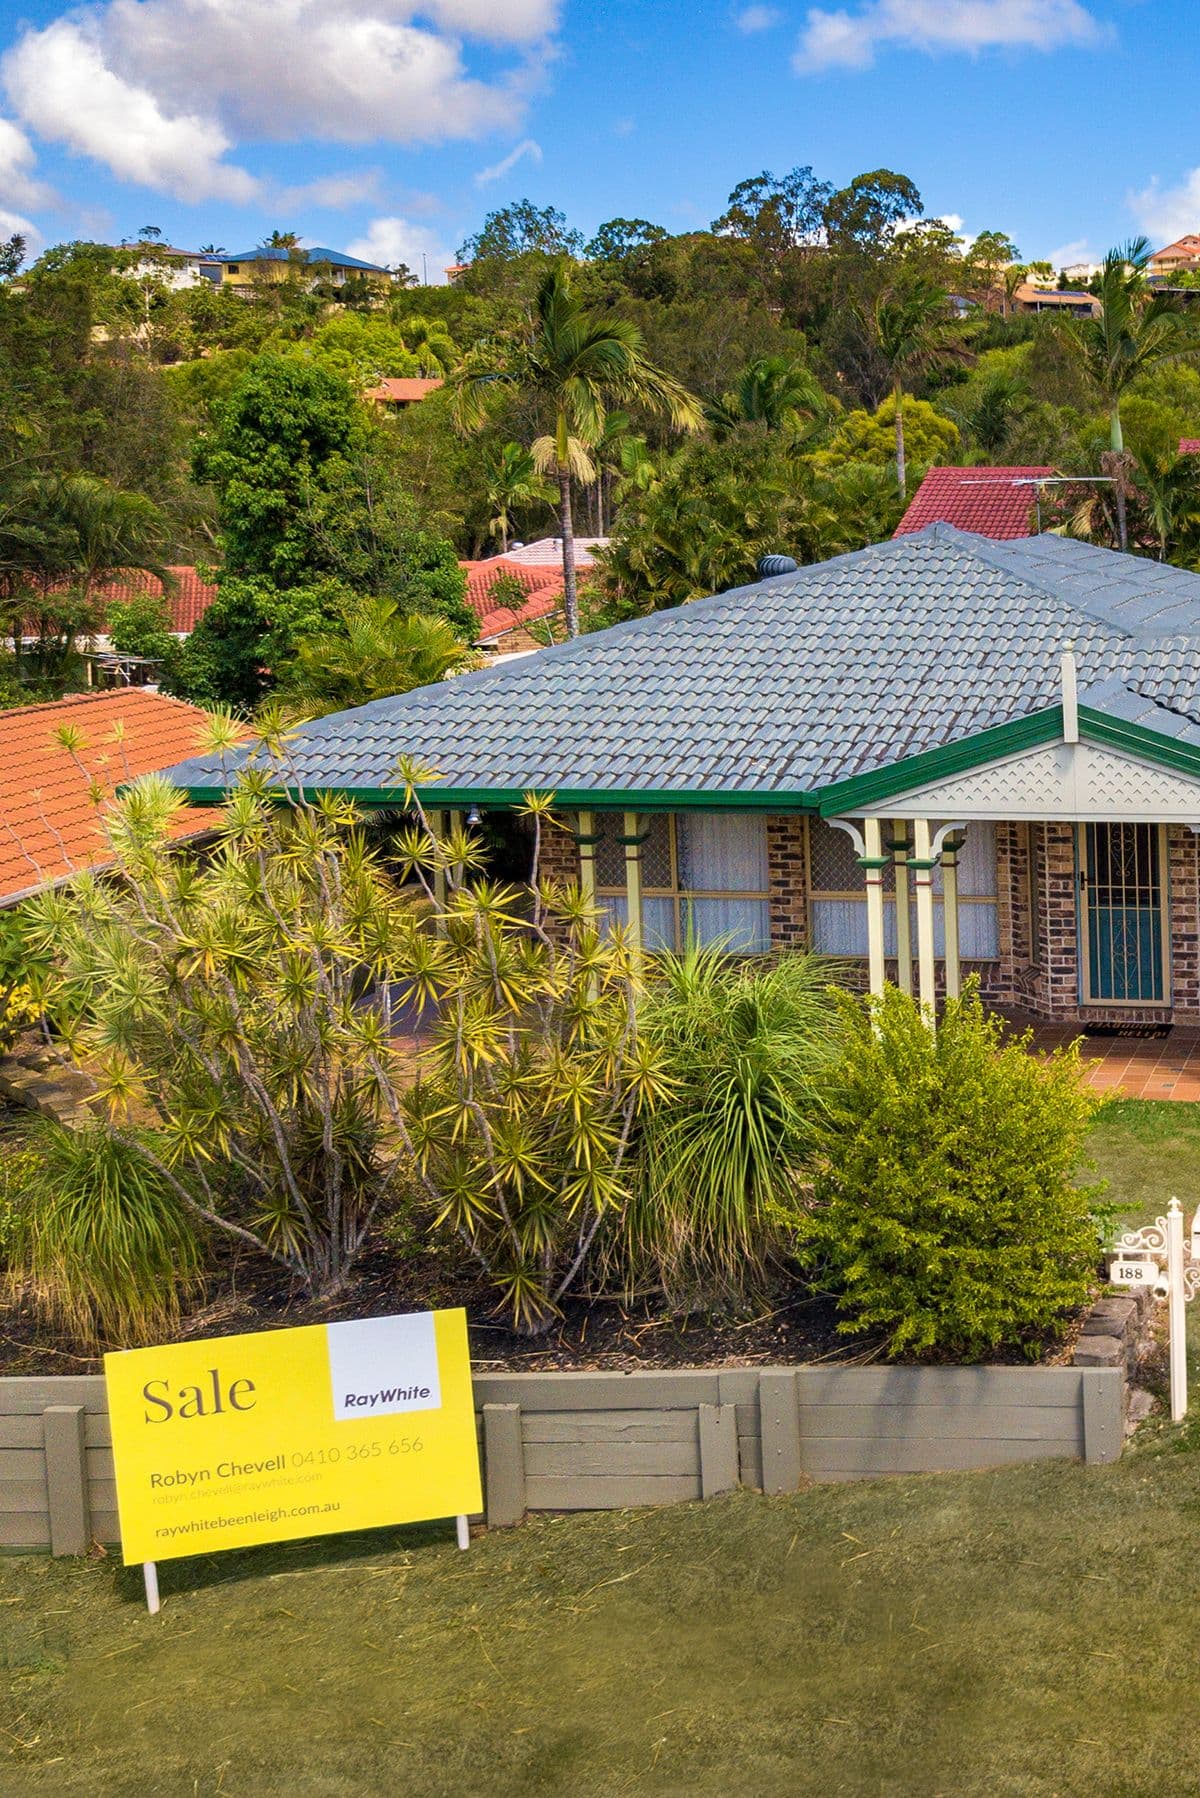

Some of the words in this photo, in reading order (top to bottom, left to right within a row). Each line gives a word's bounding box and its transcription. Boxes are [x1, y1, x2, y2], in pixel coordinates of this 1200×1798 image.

[1119, 1267, 1144, 1279] 188
[142, 1368, 257, 1424] Sale
[344, 1385, 431, 1408] RayWhite
[150, 1468, 211, 1489] Robyn
[216, 1455, 286, 1478] Chevell
[291, 1446, 340, 1468] 0410
[347, 1440, 382, 1461] 365
[388, 1436, 424, 1455] 656
[155, 1502, 341, 1539] raywhitebeenleigh.com.au
